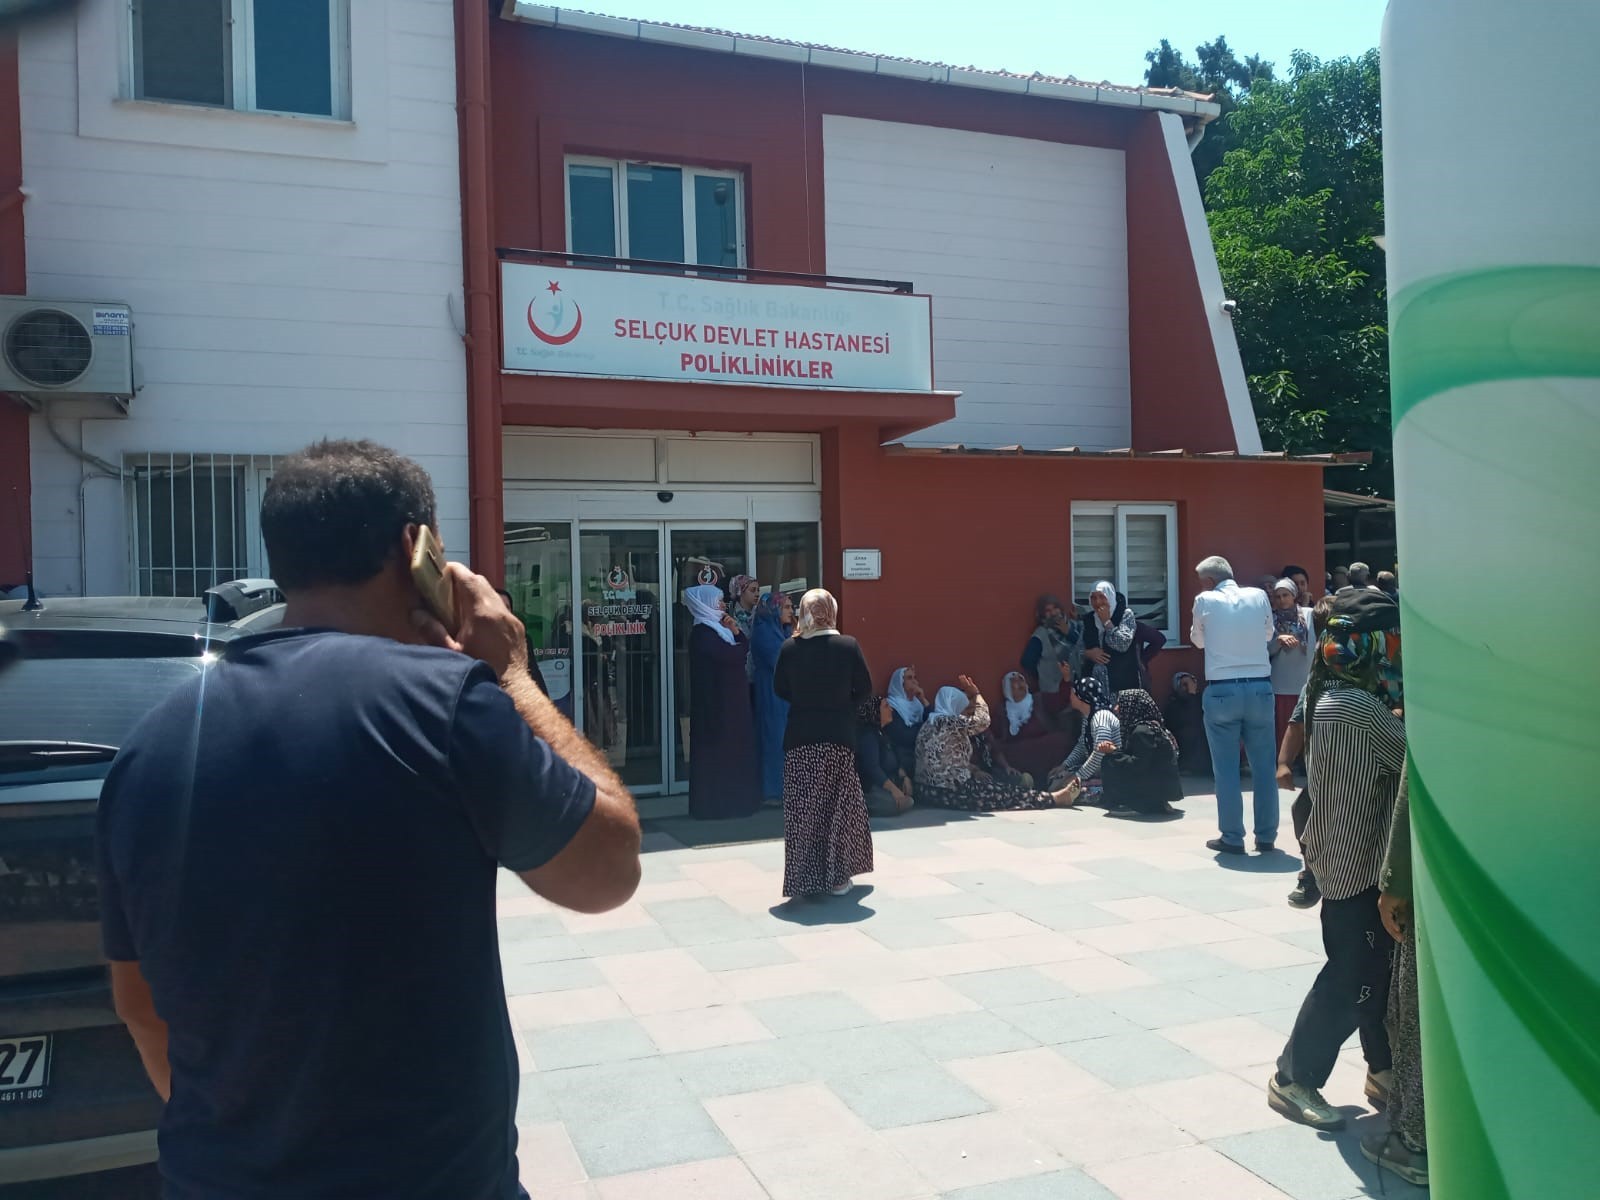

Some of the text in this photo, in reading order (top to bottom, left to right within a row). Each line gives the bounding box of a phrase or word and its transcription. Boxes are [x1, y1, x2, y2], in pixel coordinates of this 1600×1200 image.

[700, 296, 760, 321] Sağlık
[614, 318, 890, 355] SELÇUK DEVLET HASTANESİ
[680, 351, 834, 380] POLİKLİNİKLER
[587, 603, 653, 618] SELÇUK DEVLET
[593, 617, 647, 636] POLİKLİNİK
